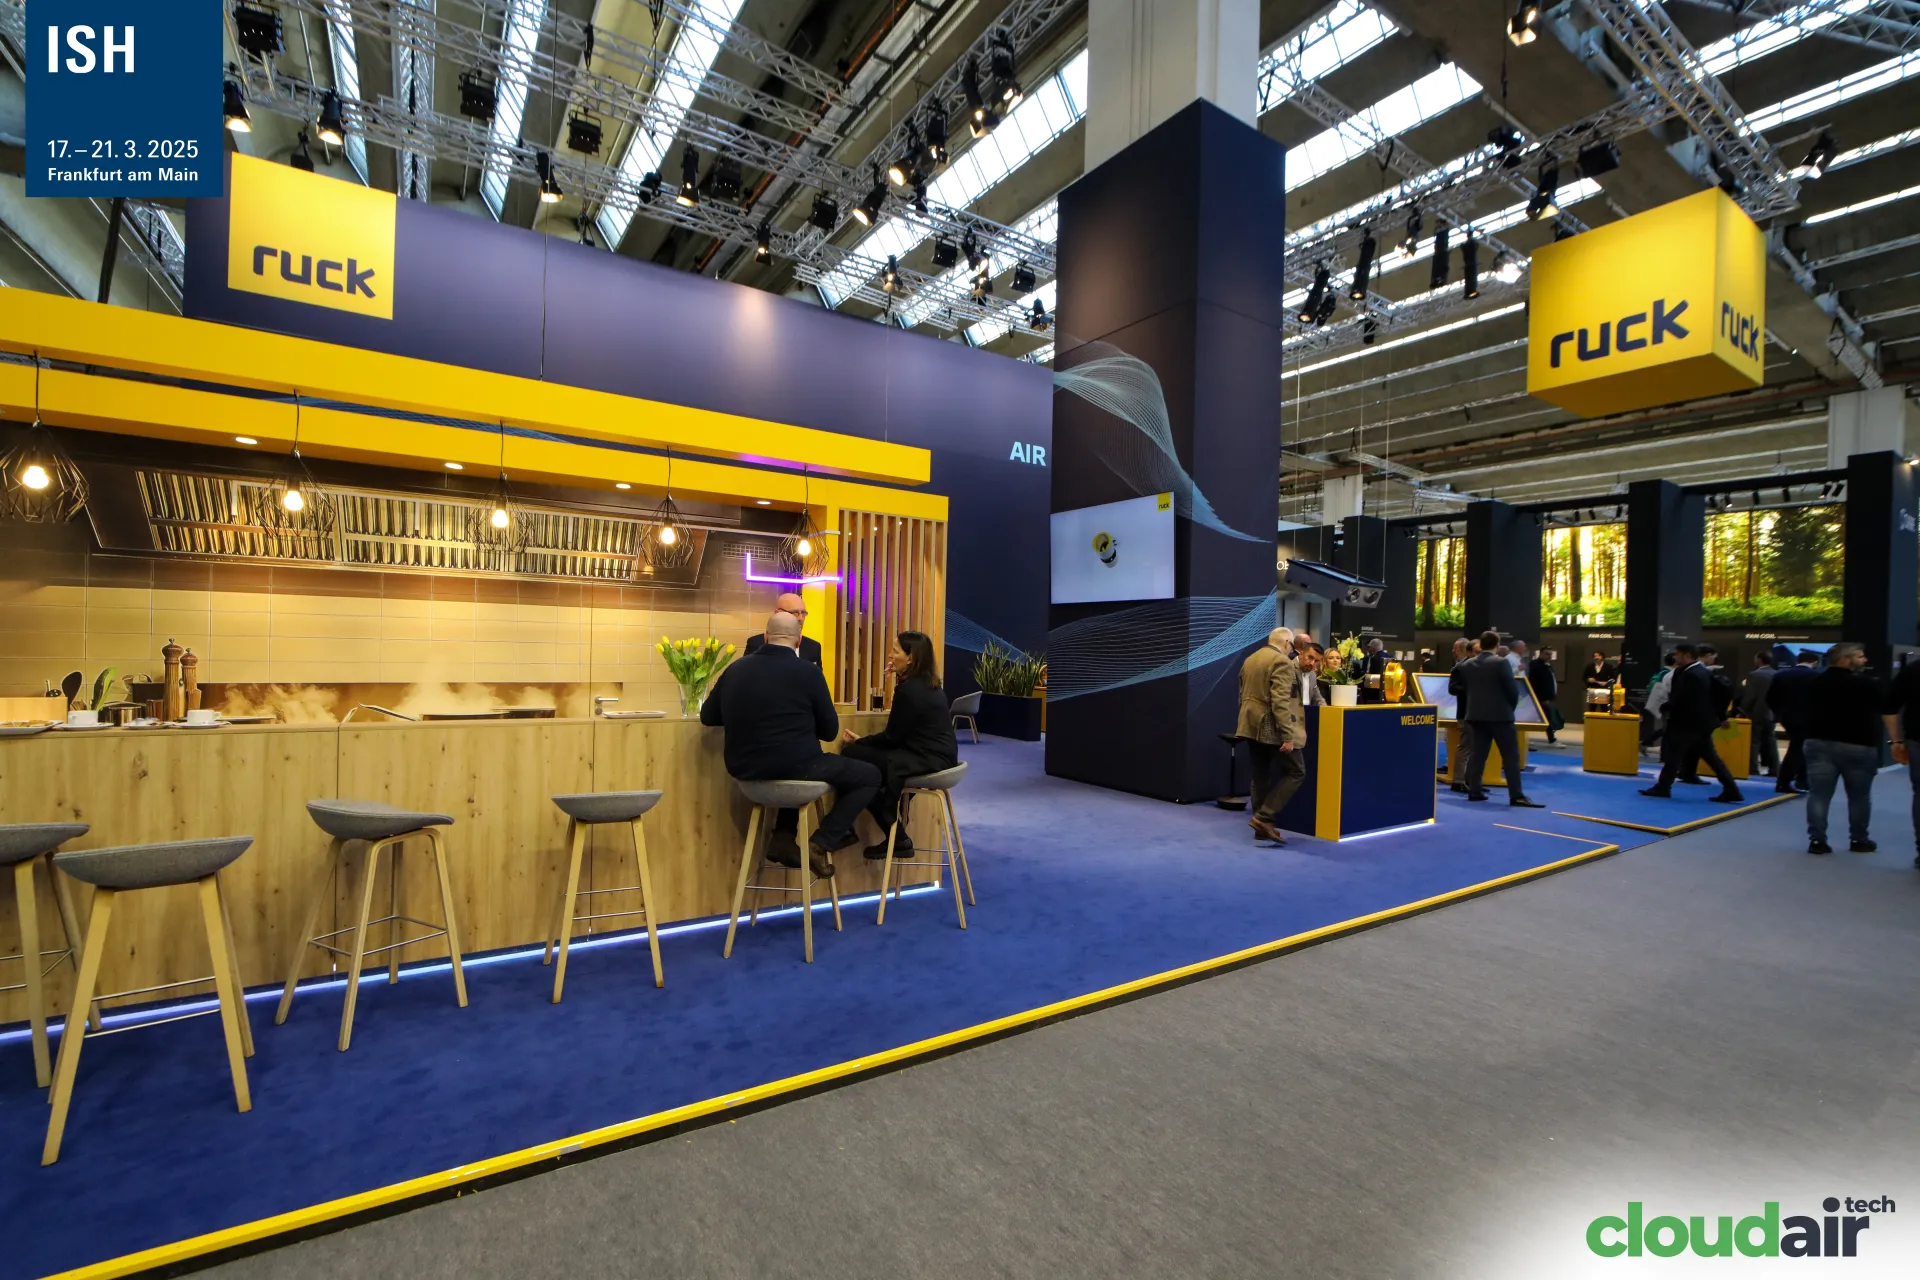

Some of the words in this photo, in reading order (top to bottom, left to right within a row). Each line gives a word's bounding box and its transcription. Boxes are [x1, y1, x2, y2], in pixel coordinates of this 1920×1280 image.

[252, 245, 377, 299] ruck
[1550, 298, 1690, 368] ruck
[1721, 301, 1760, 362] ruck
[1009, 441, 1047, 467] AIR
[1553, 613, 1605, 625] TIME
[1401, 714, 1435, 726] WELCOME
